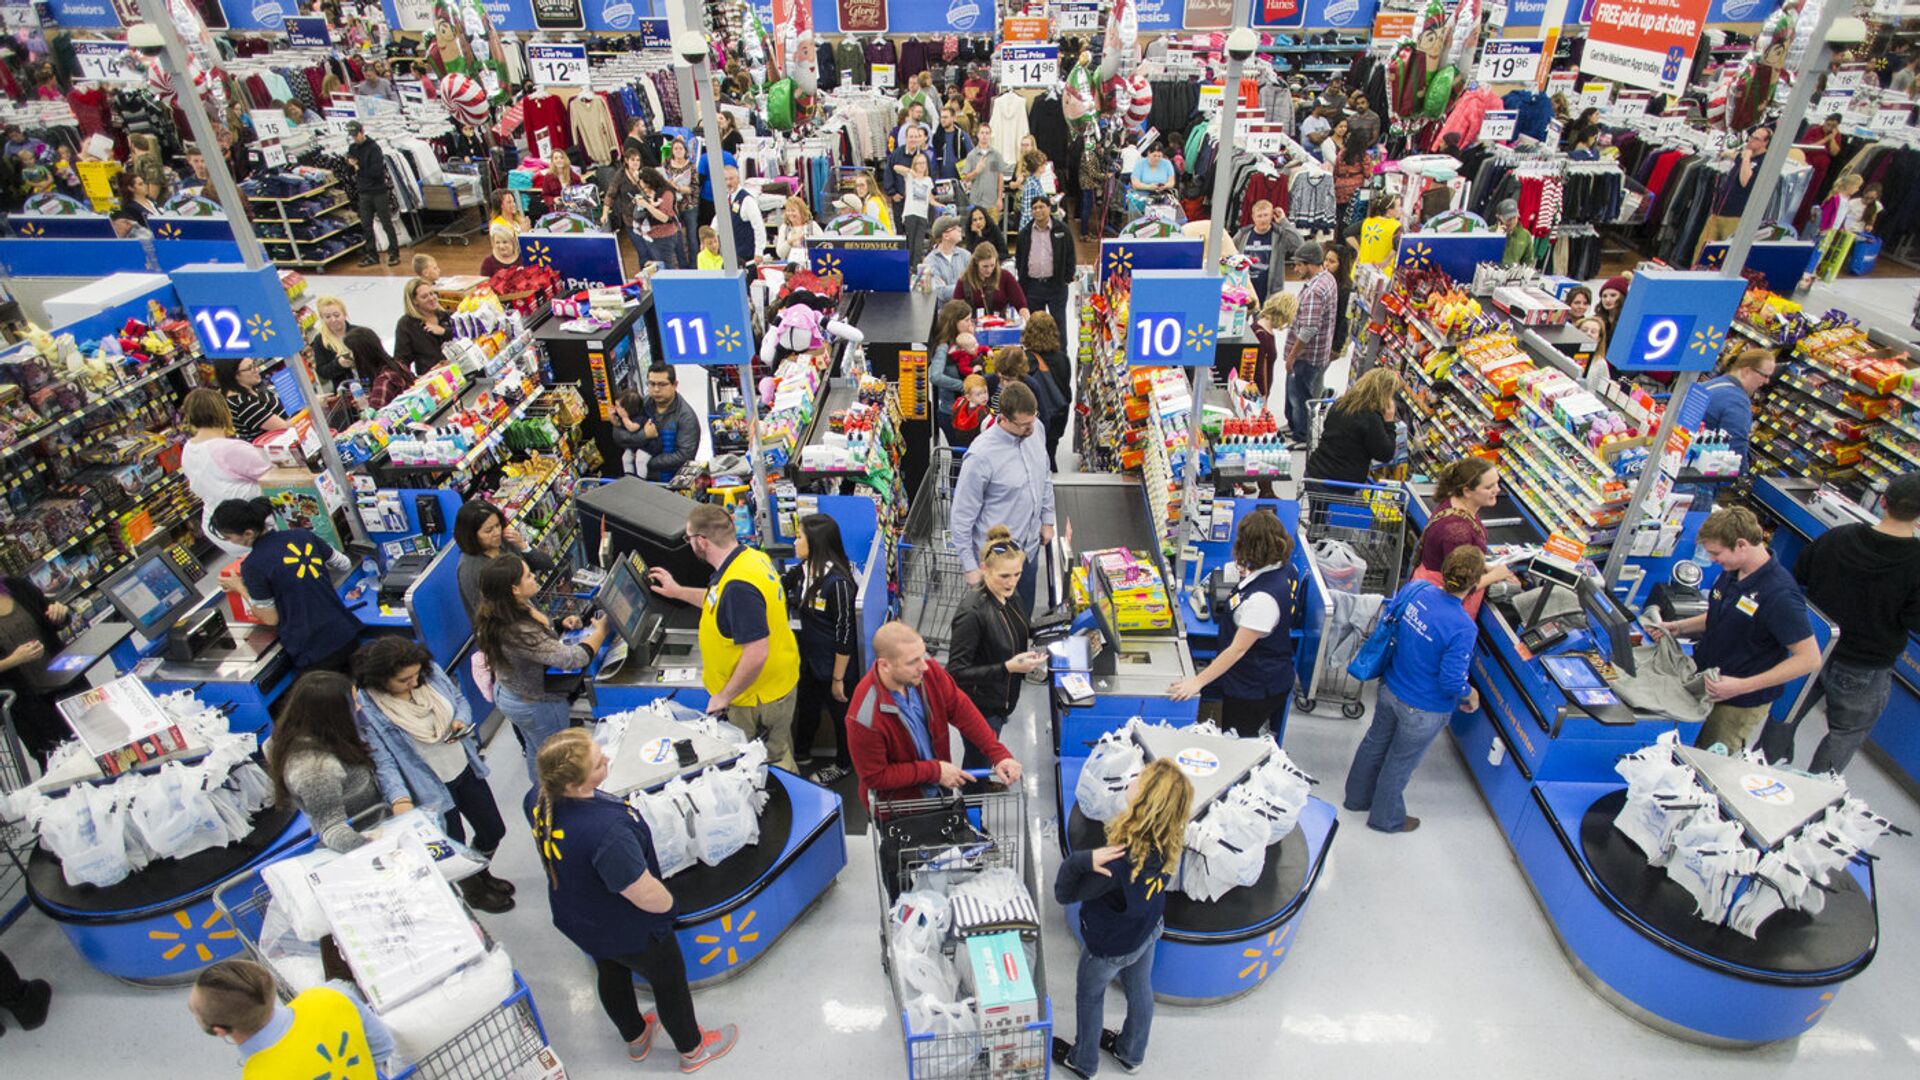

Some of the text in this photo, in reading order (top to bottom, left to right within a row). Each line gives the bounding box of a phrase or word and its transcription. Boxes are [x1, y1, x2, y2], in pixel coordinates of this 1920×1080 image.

[62, 4, 106, 15] Juniors
[1136, 12, 1171, 22] assics
[1266, 0, 1294, 9] Hanes
[1596, 3, 1696, 37] FREE pick up at store
[567, 277, 605, 290] Price
[196, 309, 250, 349] 12
[667, 317, 708, 355] 11
[1137, 317, 1182, 356] 10
[1644, 320, 1679, 360] 9
